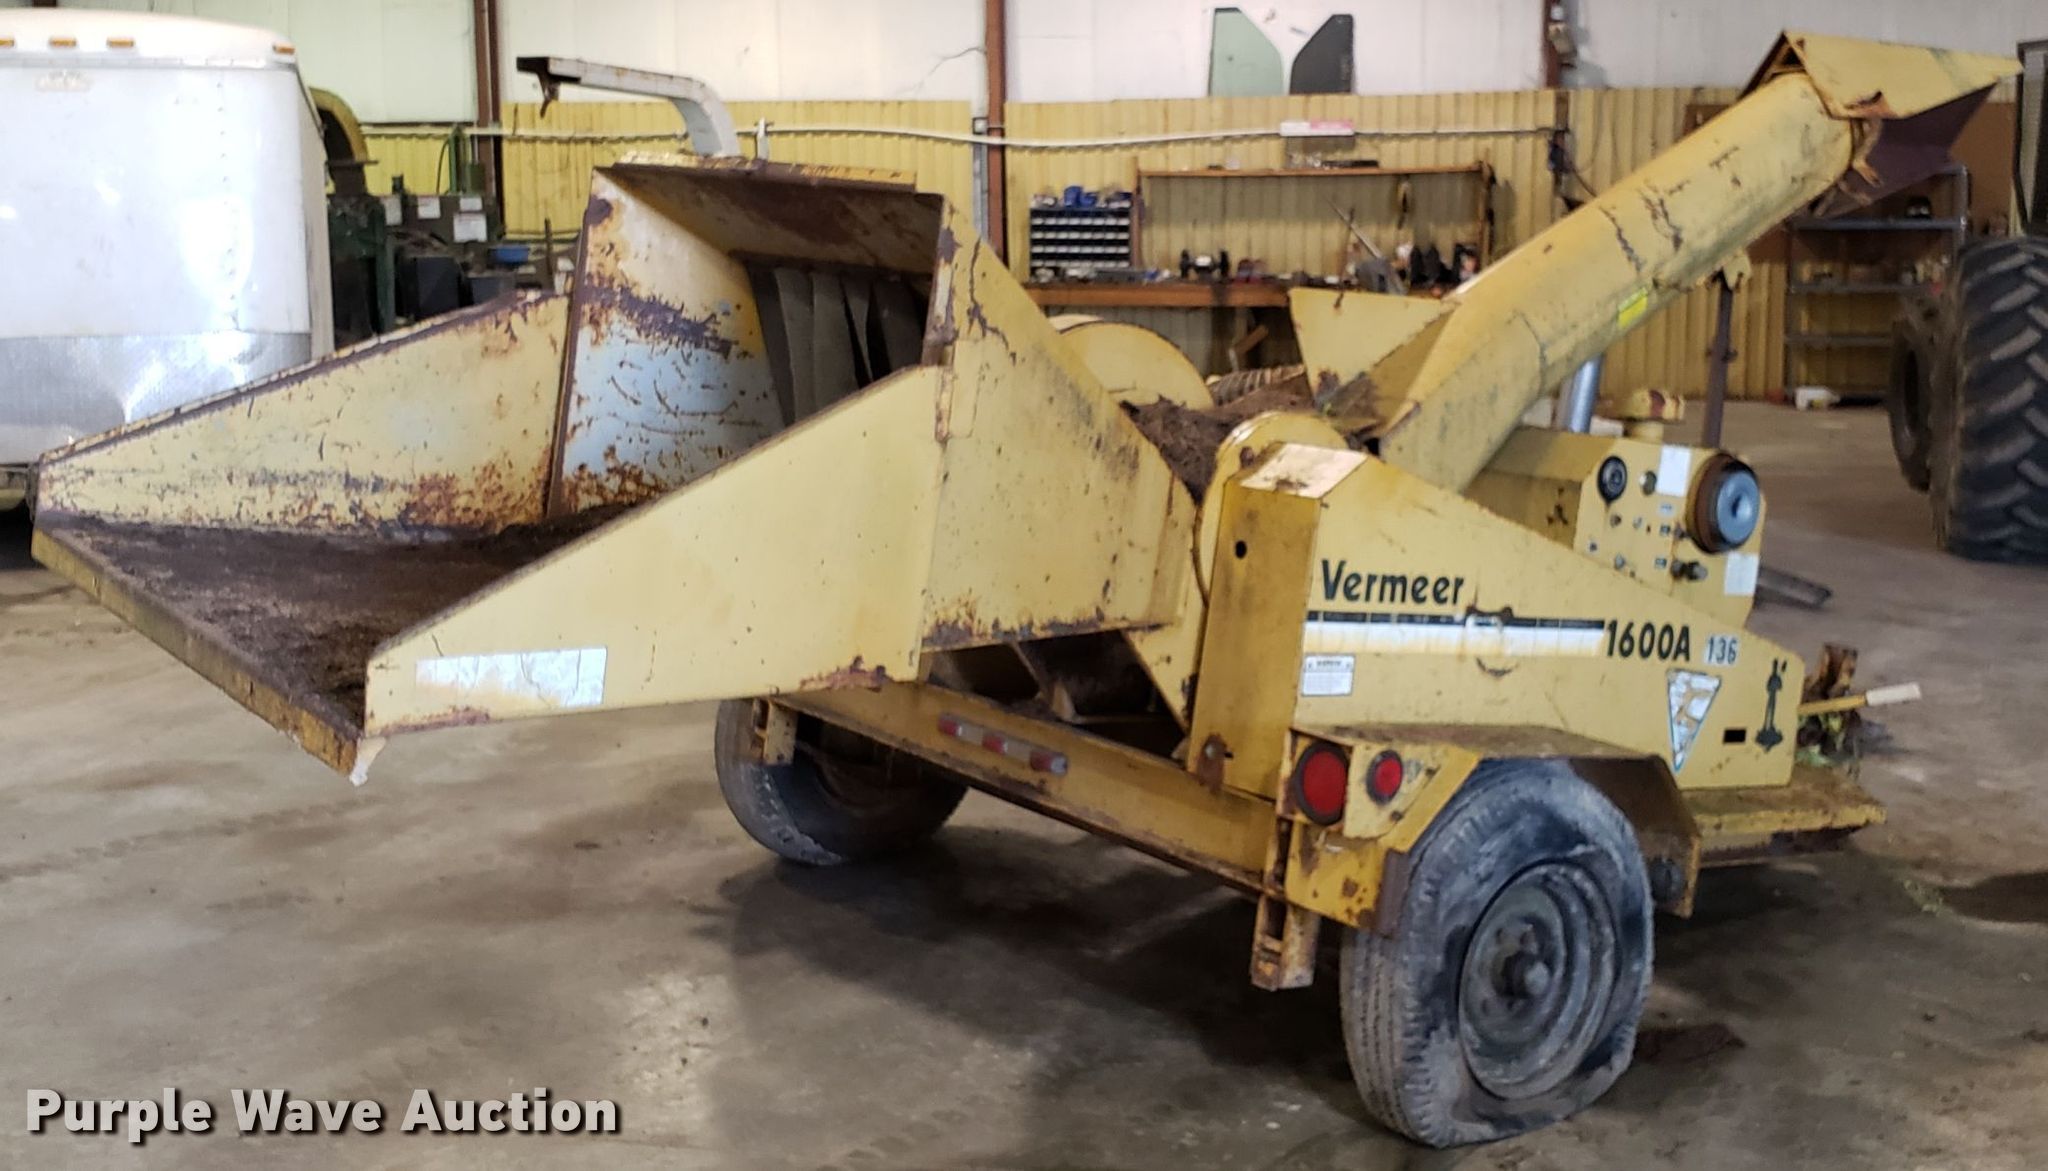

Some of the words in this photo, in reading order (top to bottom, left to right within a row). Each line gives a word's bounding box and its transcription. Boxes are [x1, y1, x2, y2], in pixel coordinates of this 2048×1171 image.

[1321, 558, 1464, 605] Vermeer
[1606, 618, 1690, 662] 1600A
[1707, 635, 1738, 665] 136
